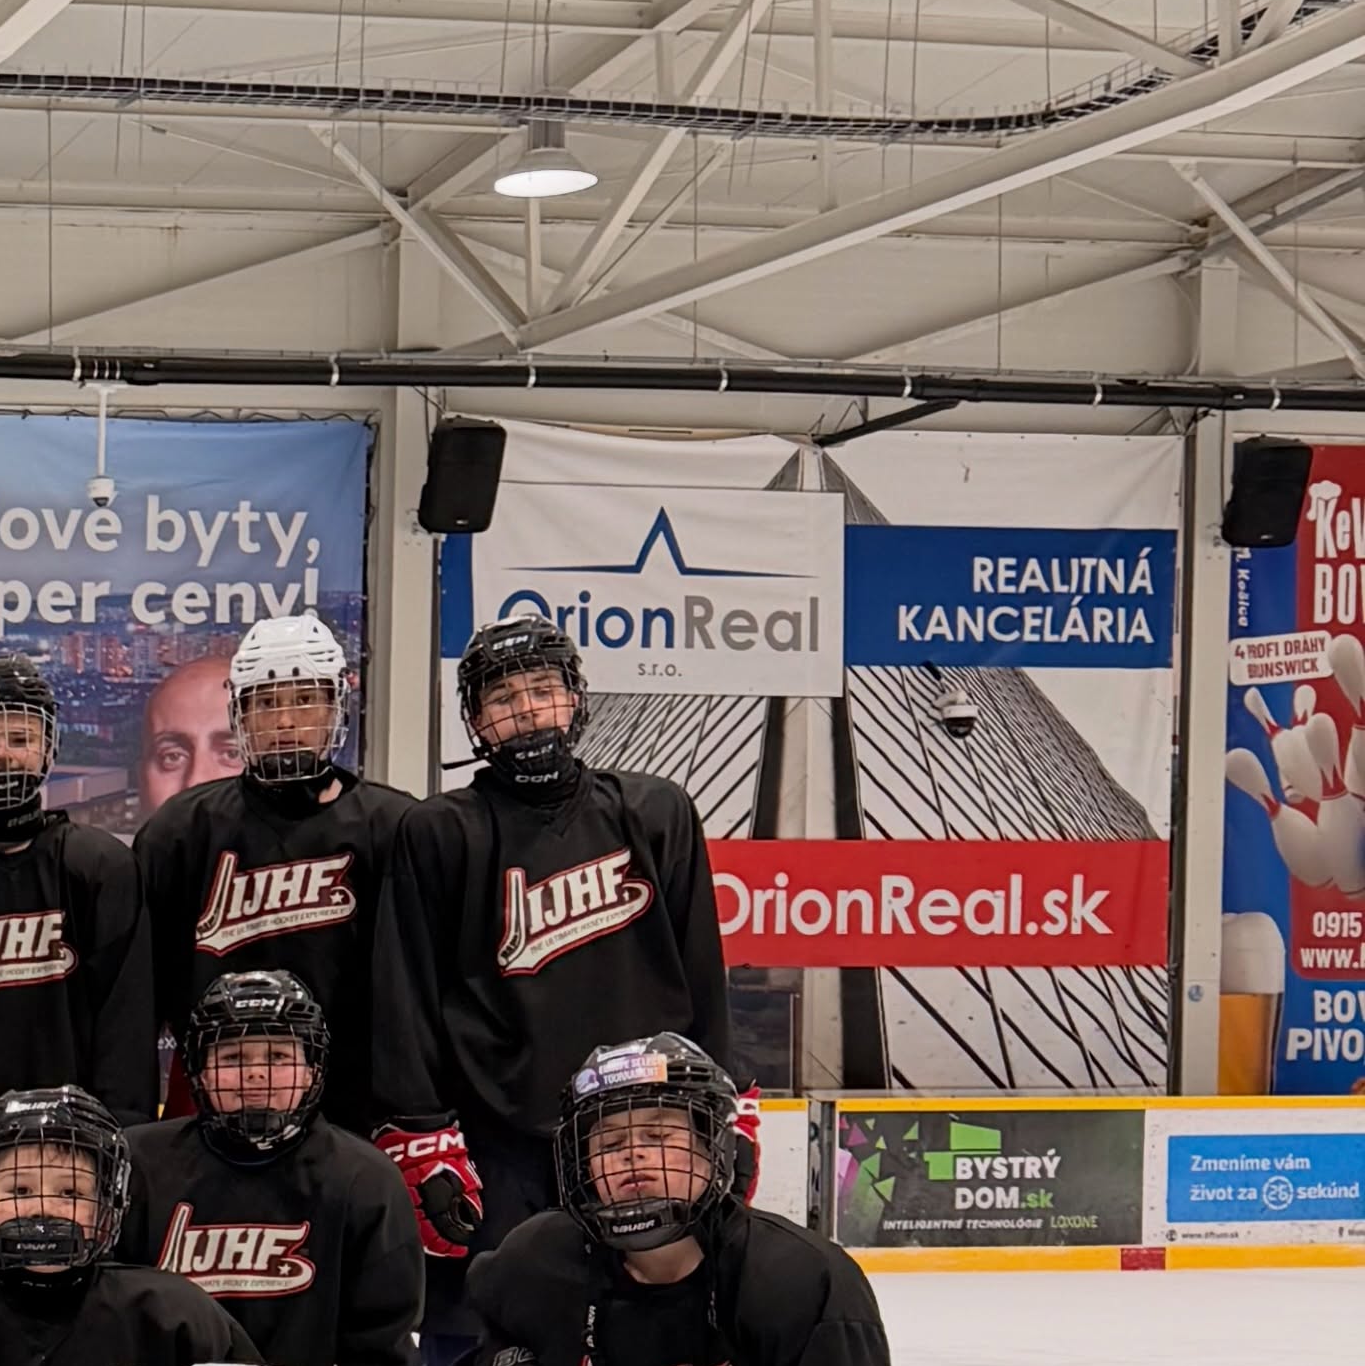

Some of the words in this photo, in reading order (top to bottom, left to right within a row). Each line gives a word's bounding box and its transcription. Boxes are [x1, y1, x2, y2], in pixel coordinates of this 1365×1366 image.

[144, 493, 321, 567] byty,
[1313, 563, 1365, 625] BO
[898, 602, 1154, 646] KANCELÁRIA
[637, 663, 682, 678] s.r.o.
[227, 853, 350, 920] IJHF
[526, 850, 631, 935] IJHF
[711, 871, 1113, 938] OrionReal.sk
[1313, 911, 1362, 938] 0915
[235, 996, 276, 1008] CCM
[956, 1149, 1061, 1179] BYSTRÝ
[1190, 1154, 1270, 1171] Zmeníme
[1274, 1153, 1310, 1170] vám
[955, 1187, 1053, 1209] DOM.sk
[1190, 1184, 1233, 1201] život
[1237, 1189, 1257, 1201] za
[1269, 1185, 1289, 1201] 26
[1297, 1183, 1360, 1199] sekúnd
[181, 1223, 309, 1273] IJHF
